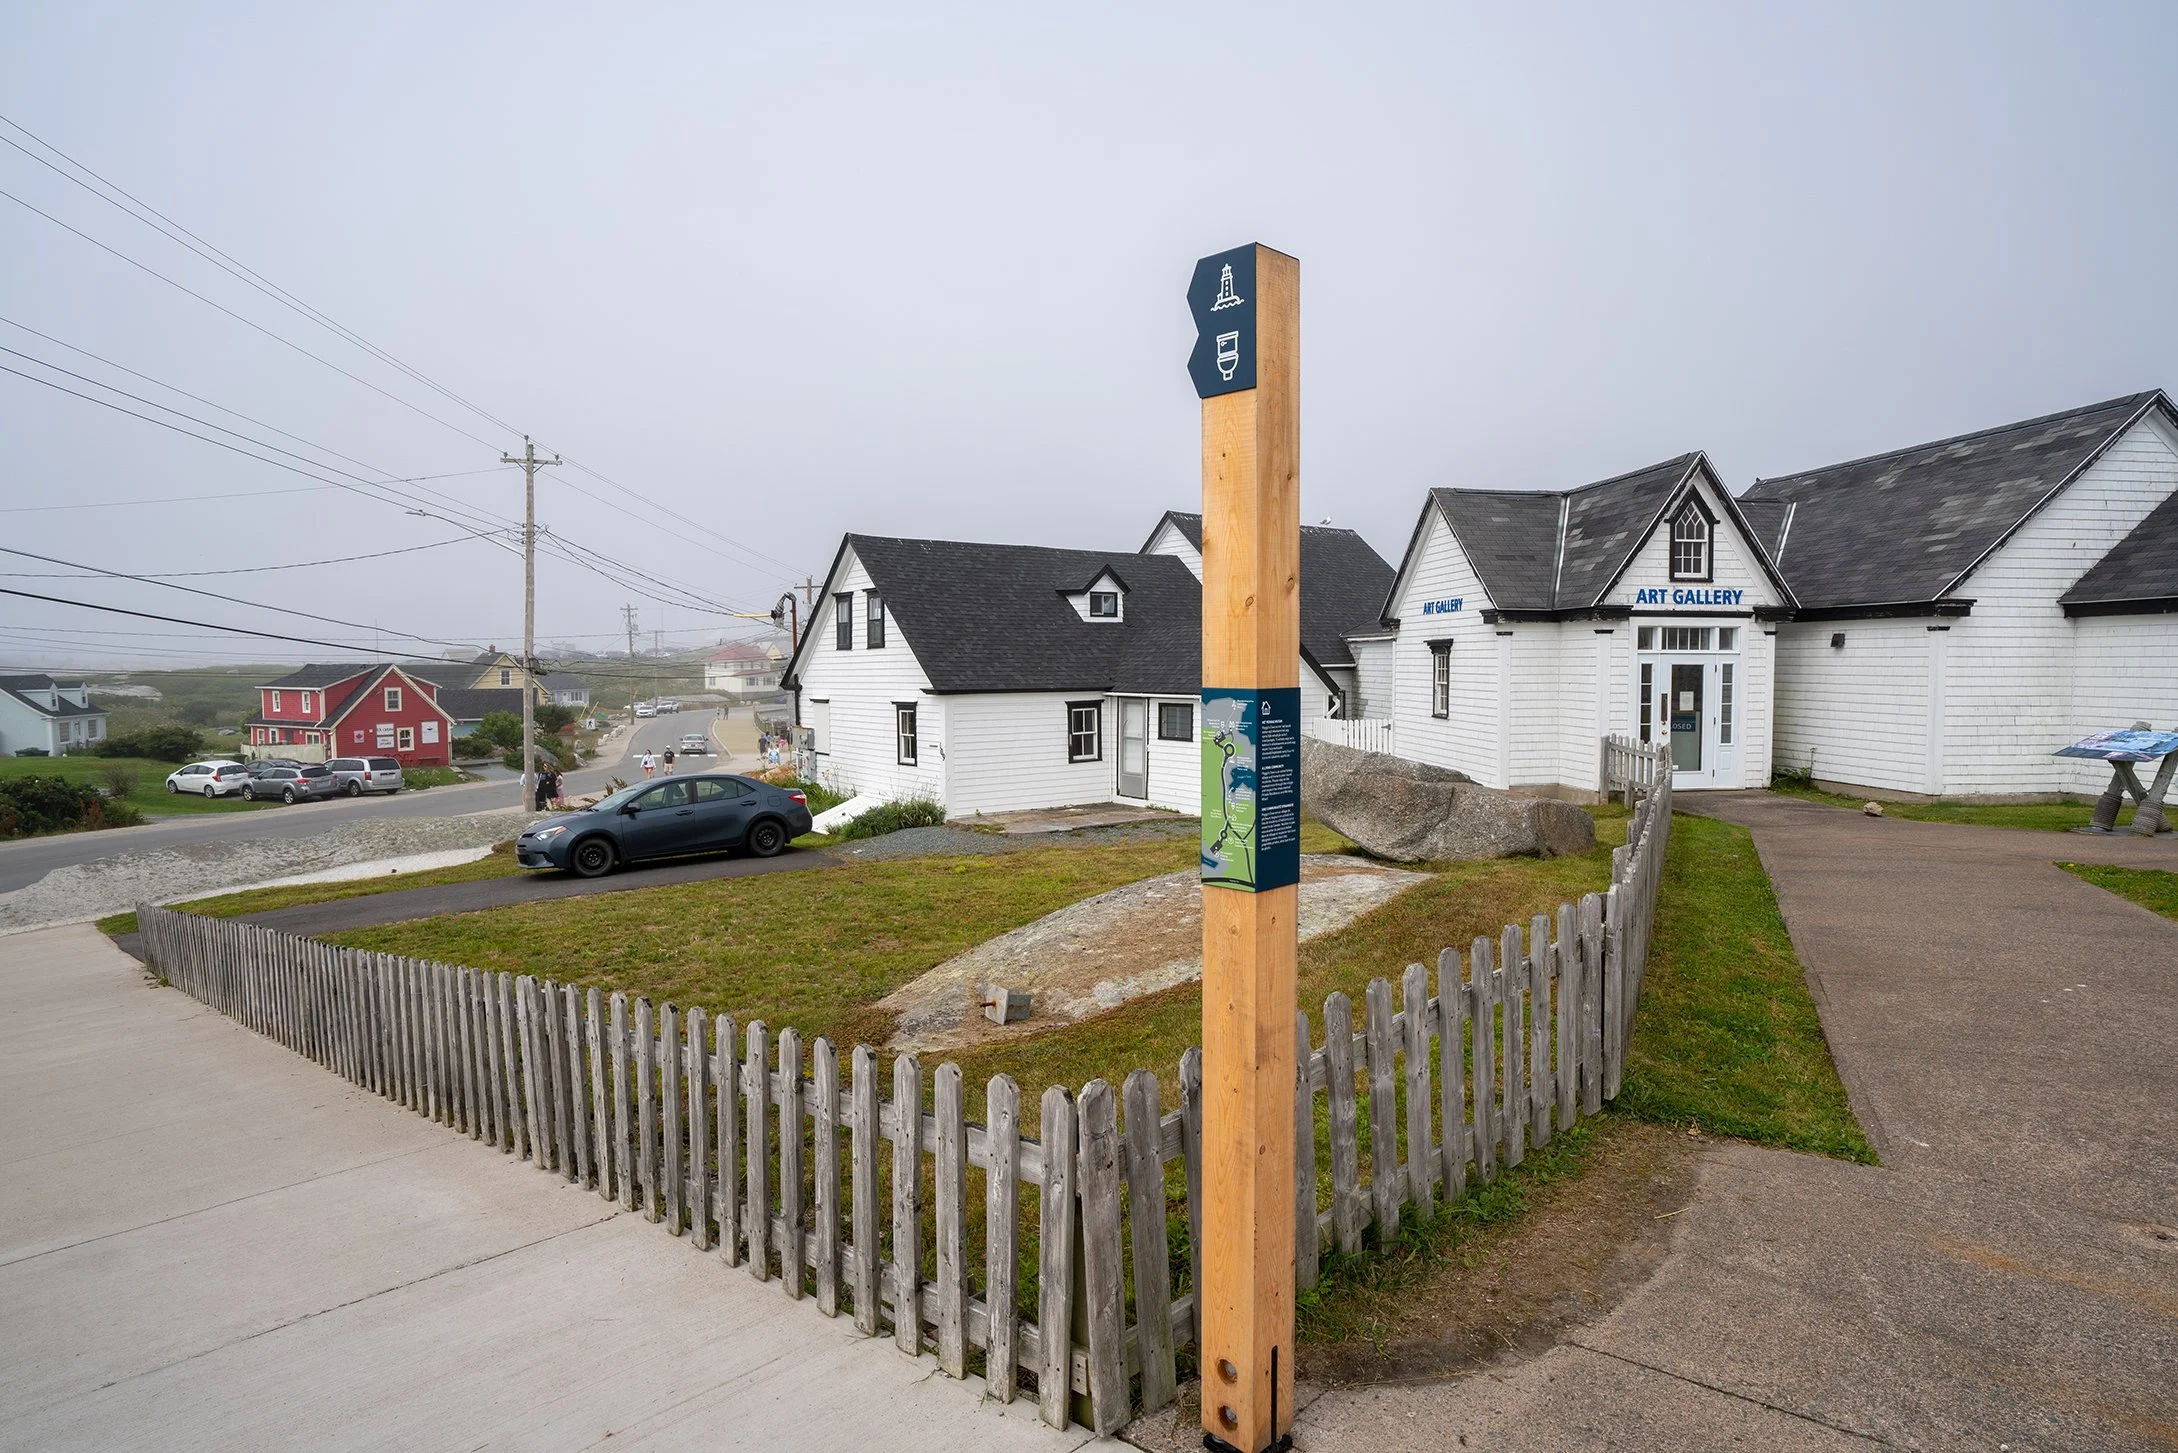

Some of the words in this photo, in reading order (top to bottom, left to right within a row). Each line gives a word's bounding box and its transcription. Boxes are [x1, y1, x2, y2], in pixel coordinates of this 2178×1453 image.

[1636, 589, 1667, 603] ART
[1673, 589, 1743, 604] GALLERY
[1423, 601, 1435, 615] ART
[1435, 598, 1464, 614] GALLERY
